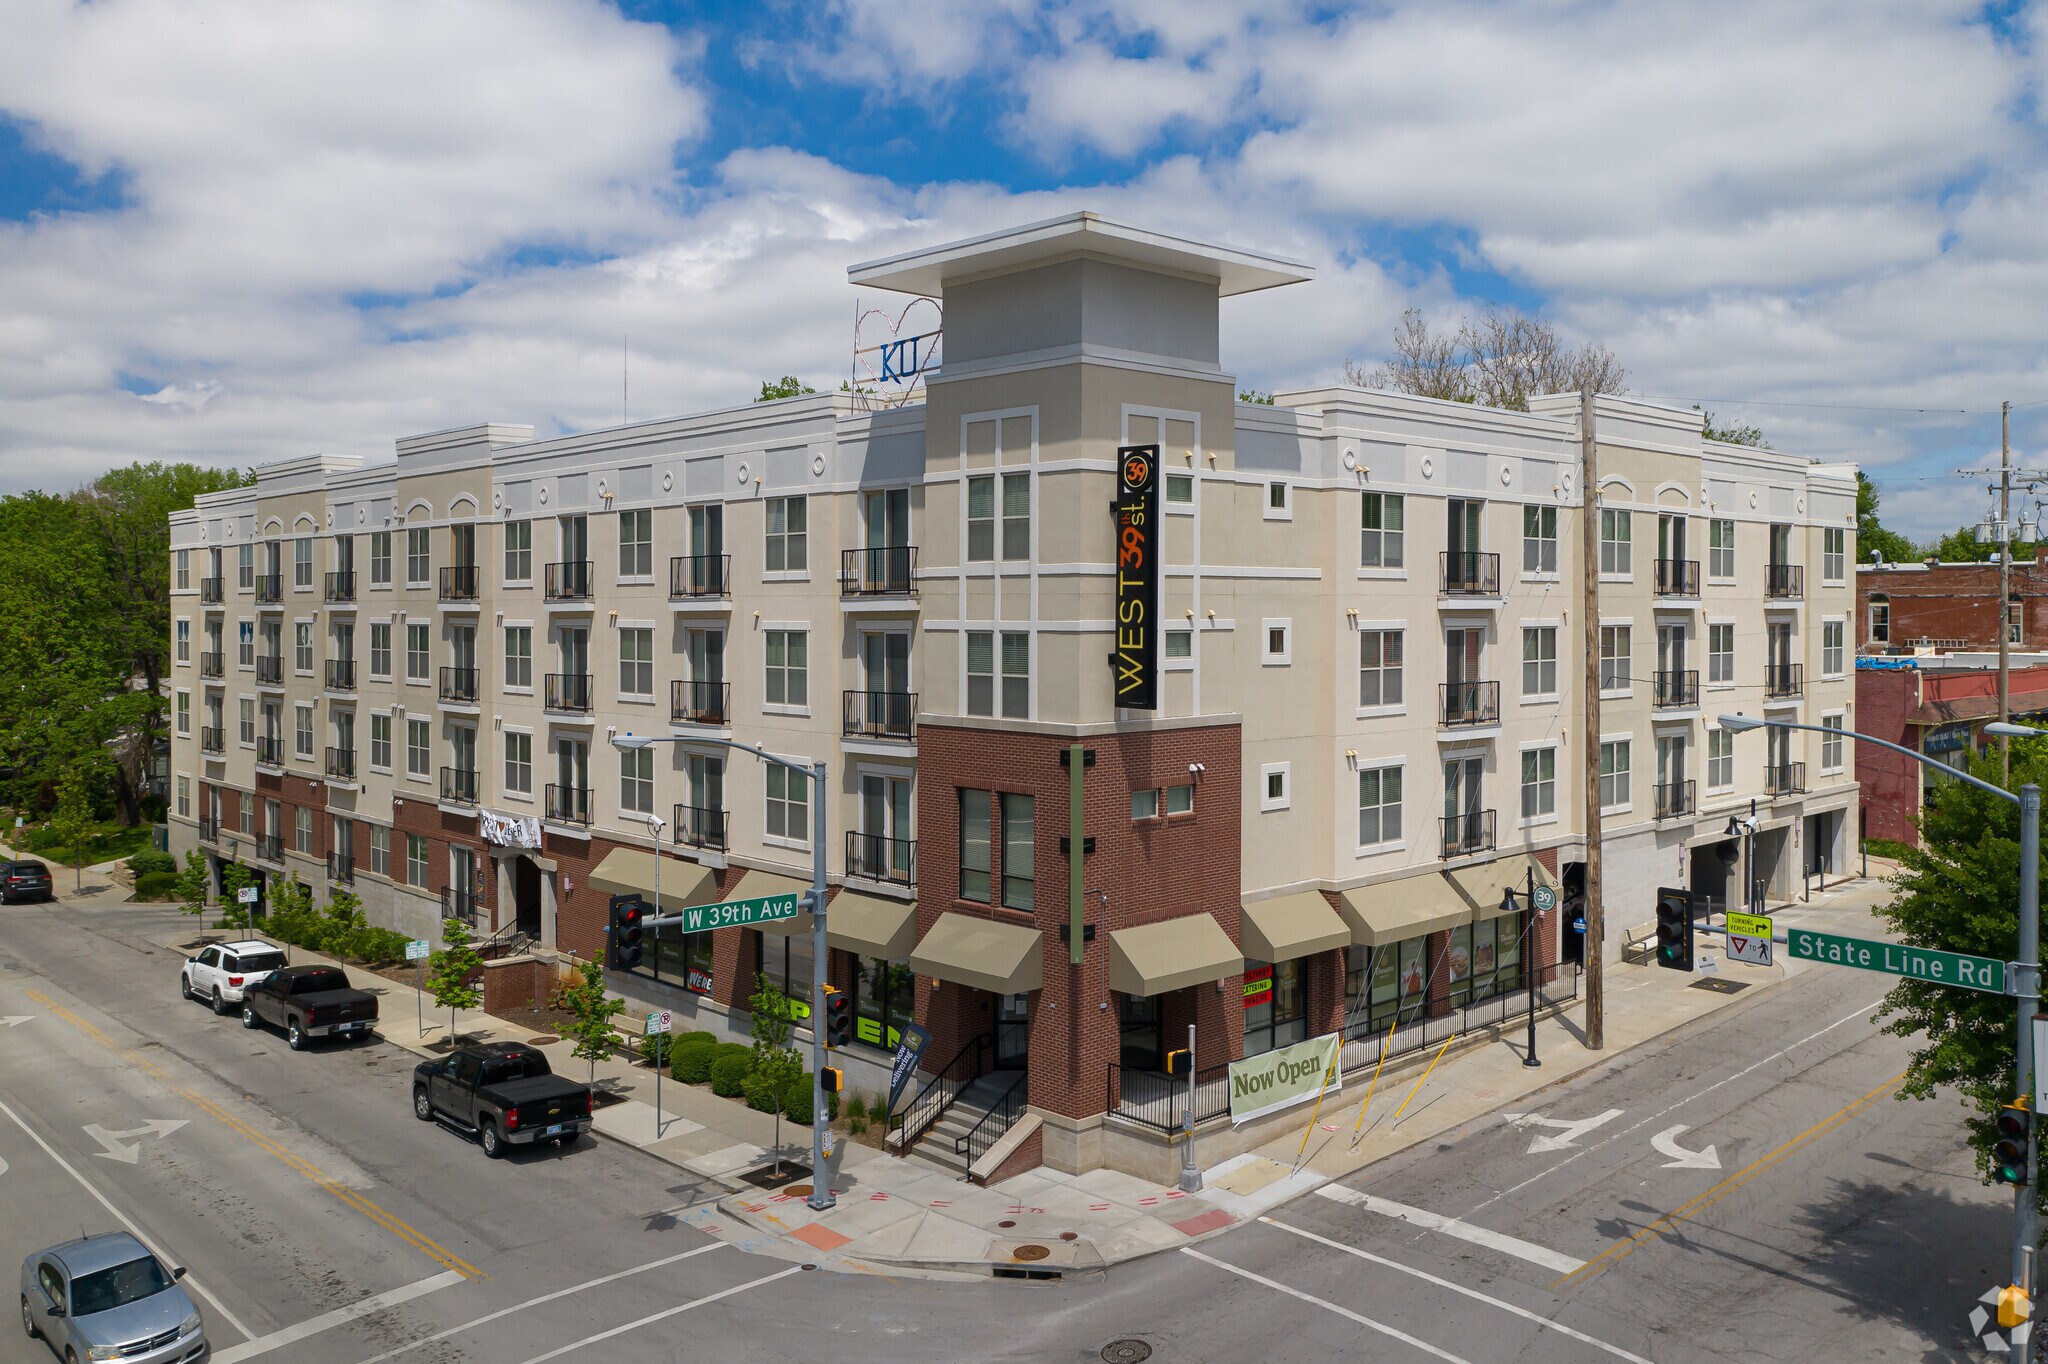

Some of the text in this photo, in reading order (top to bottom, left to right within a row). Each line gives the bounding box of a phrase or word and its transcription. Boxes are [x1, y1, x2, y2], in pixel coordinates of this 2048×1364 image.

[880, 336, 920, 384] KU
[1127, 462, 1147, 482] 39
[1118, 570, 1145, 695] WEST
[1537, 891, 1551, 903] 39
[688, 900, 793, 929] W 39th Ave
[1731, 917, 1754, 926] TURNING
[1730, 924, 1755, 934] VEHICLES
[1749, 944, 1757, 952] TO
[1798, 934, 1992, 987] State Line Rd
[1234, 1055, 1321, 1098] Now Open
